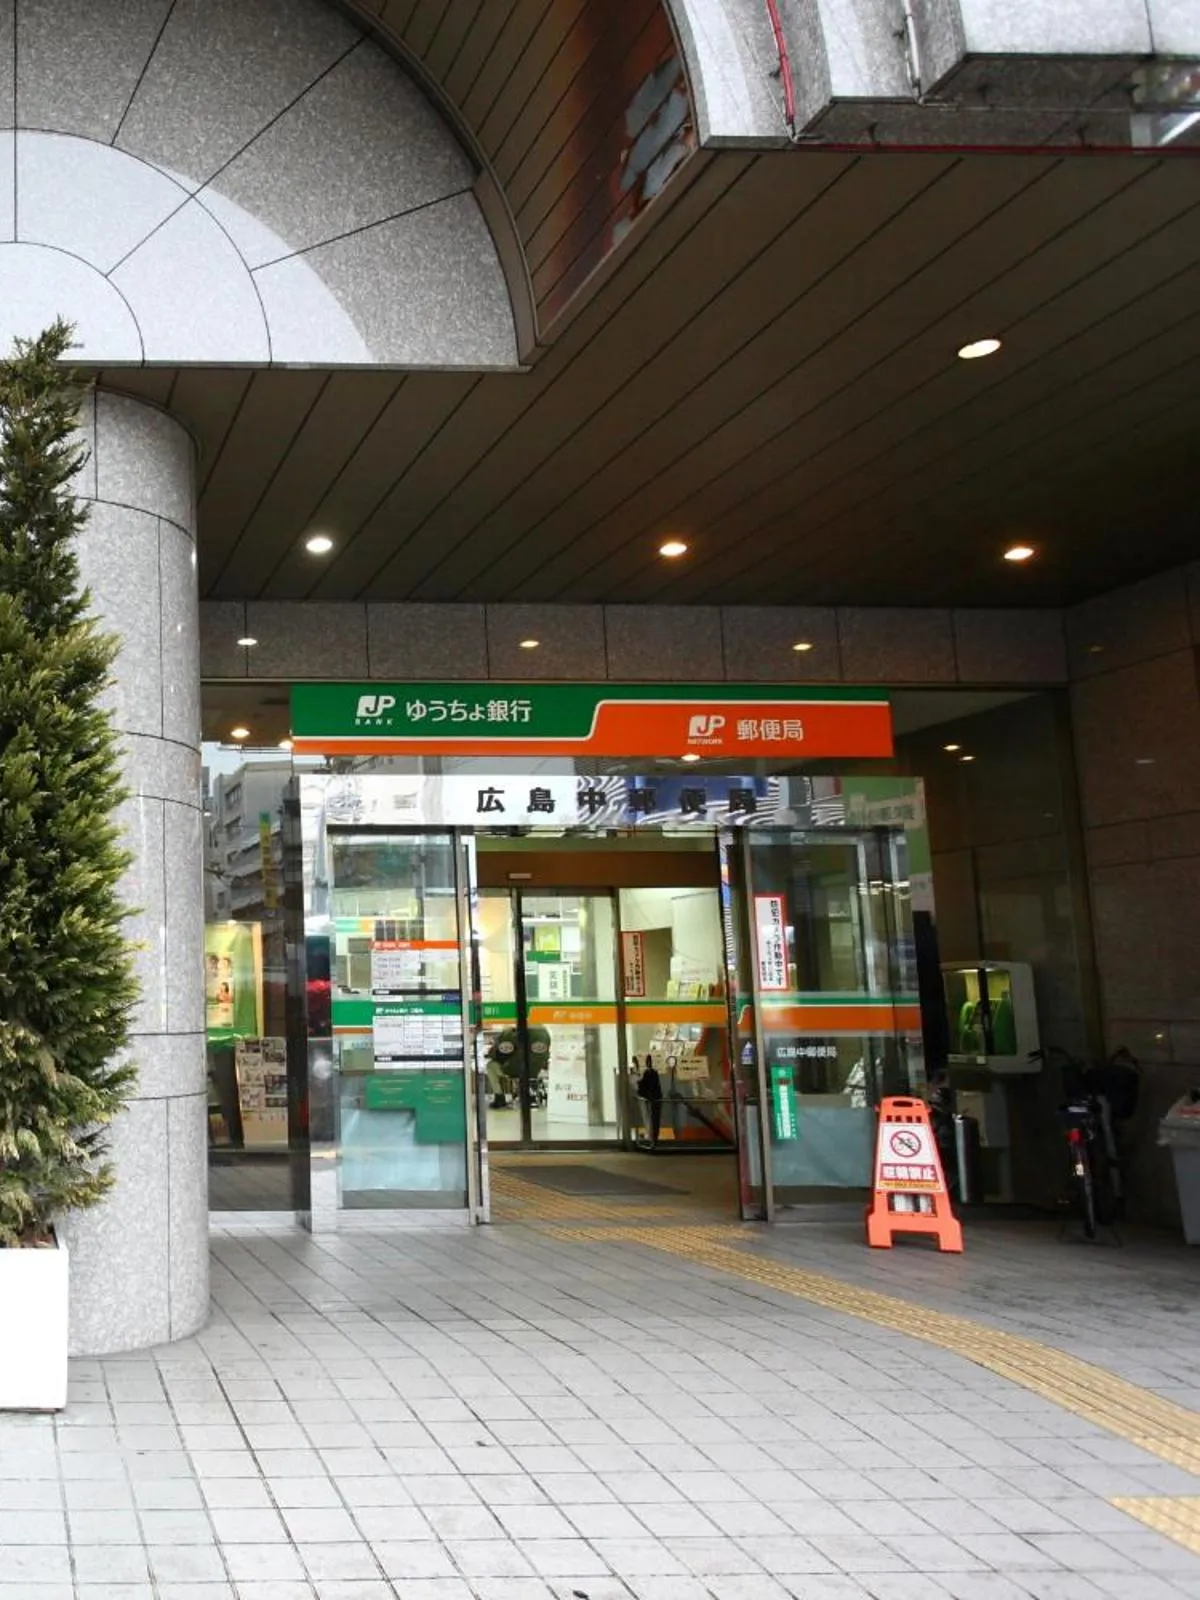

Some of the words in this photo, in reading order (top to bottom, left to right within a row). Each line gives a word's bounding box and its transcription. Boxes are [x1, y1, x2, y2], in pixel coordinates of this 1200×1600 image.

[354, 718, 394, 726] BANK
[356, 695, 396, 718] JP
[406, 699, 533, 723] ゆうちょ銀行
[688, 714, 726, 737] JP
[736, 719, 804, 741] 郵便局
[475, 786, 758, 815] 広島中郵便局
[776, 1046, 837, 1059] 広島中郵便局
